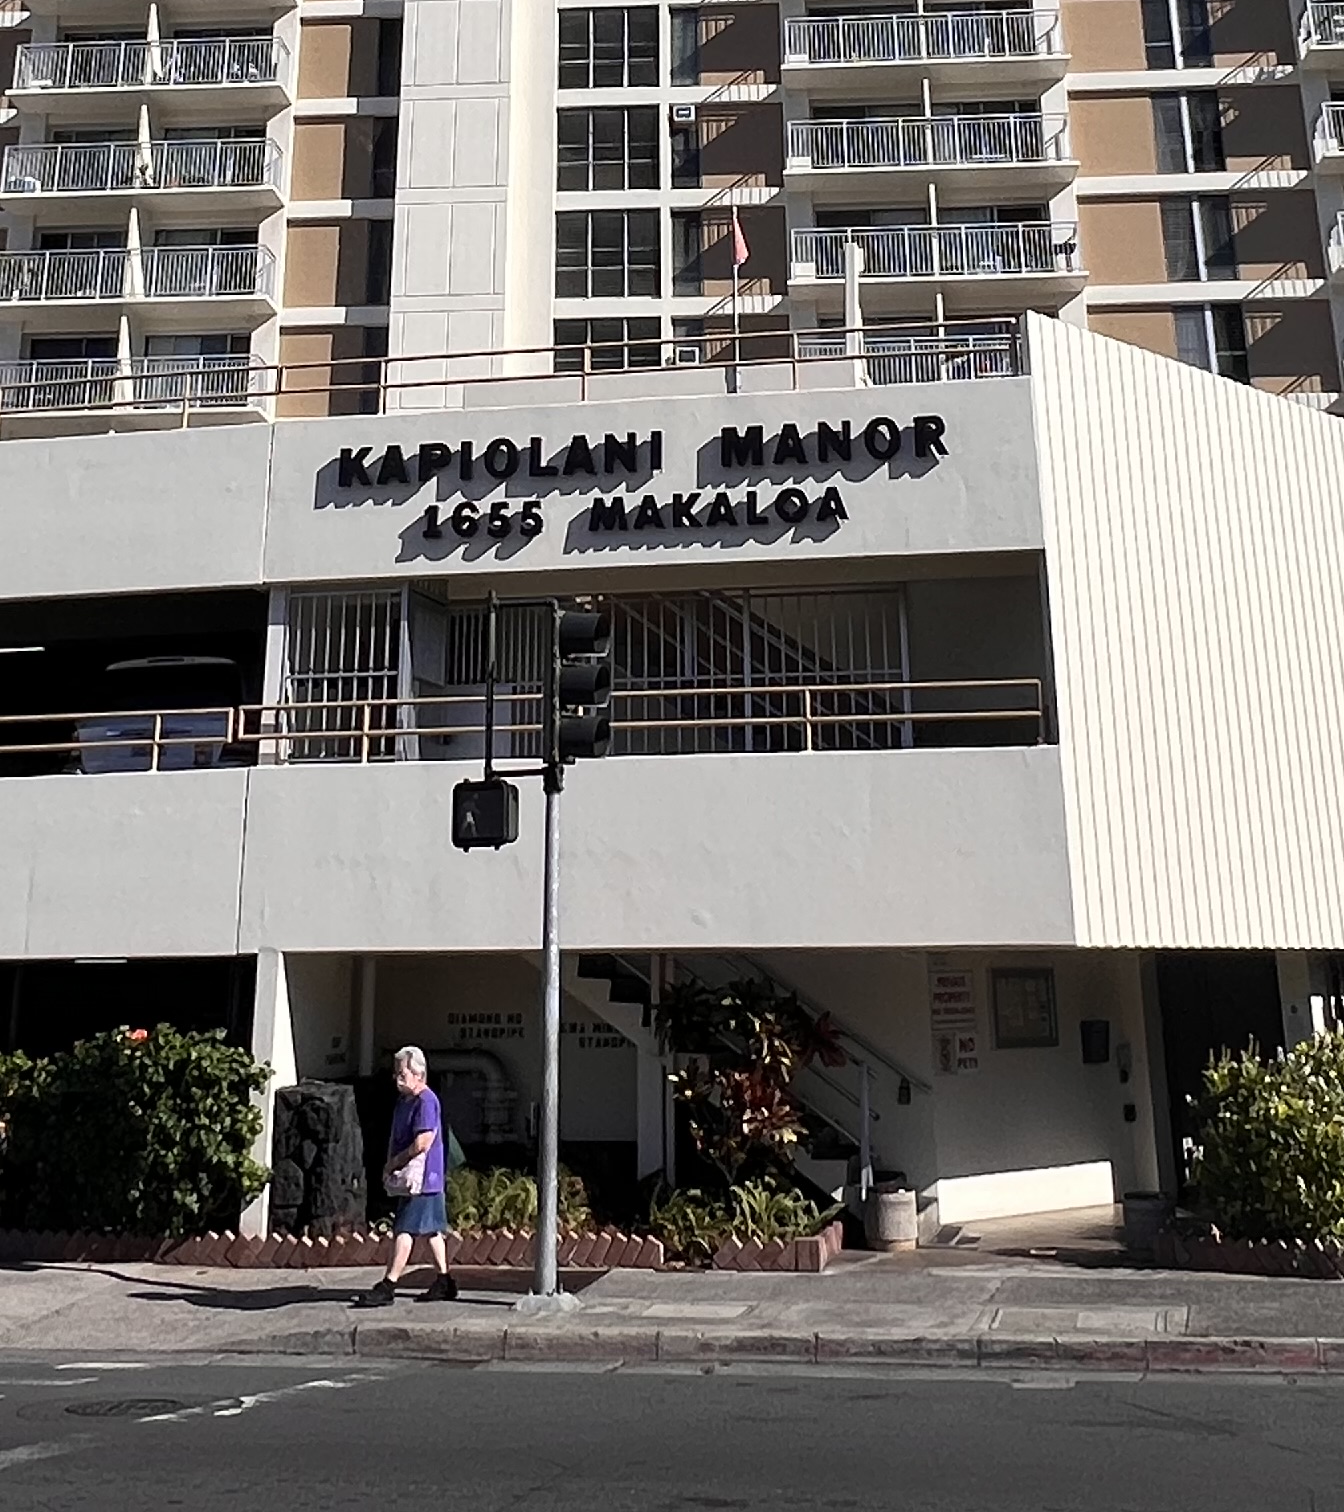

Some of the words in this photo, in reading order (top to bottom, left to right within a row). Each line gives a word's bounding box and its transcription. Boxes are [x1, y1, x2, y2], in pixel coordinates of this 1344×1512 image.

[338, 430, 663, 488] KAPIOLANI
[720, 415, 950, 469] MANOR
[422, 500, 545, 540] 1655
[589, 486, 849, 533] MAKALOA
